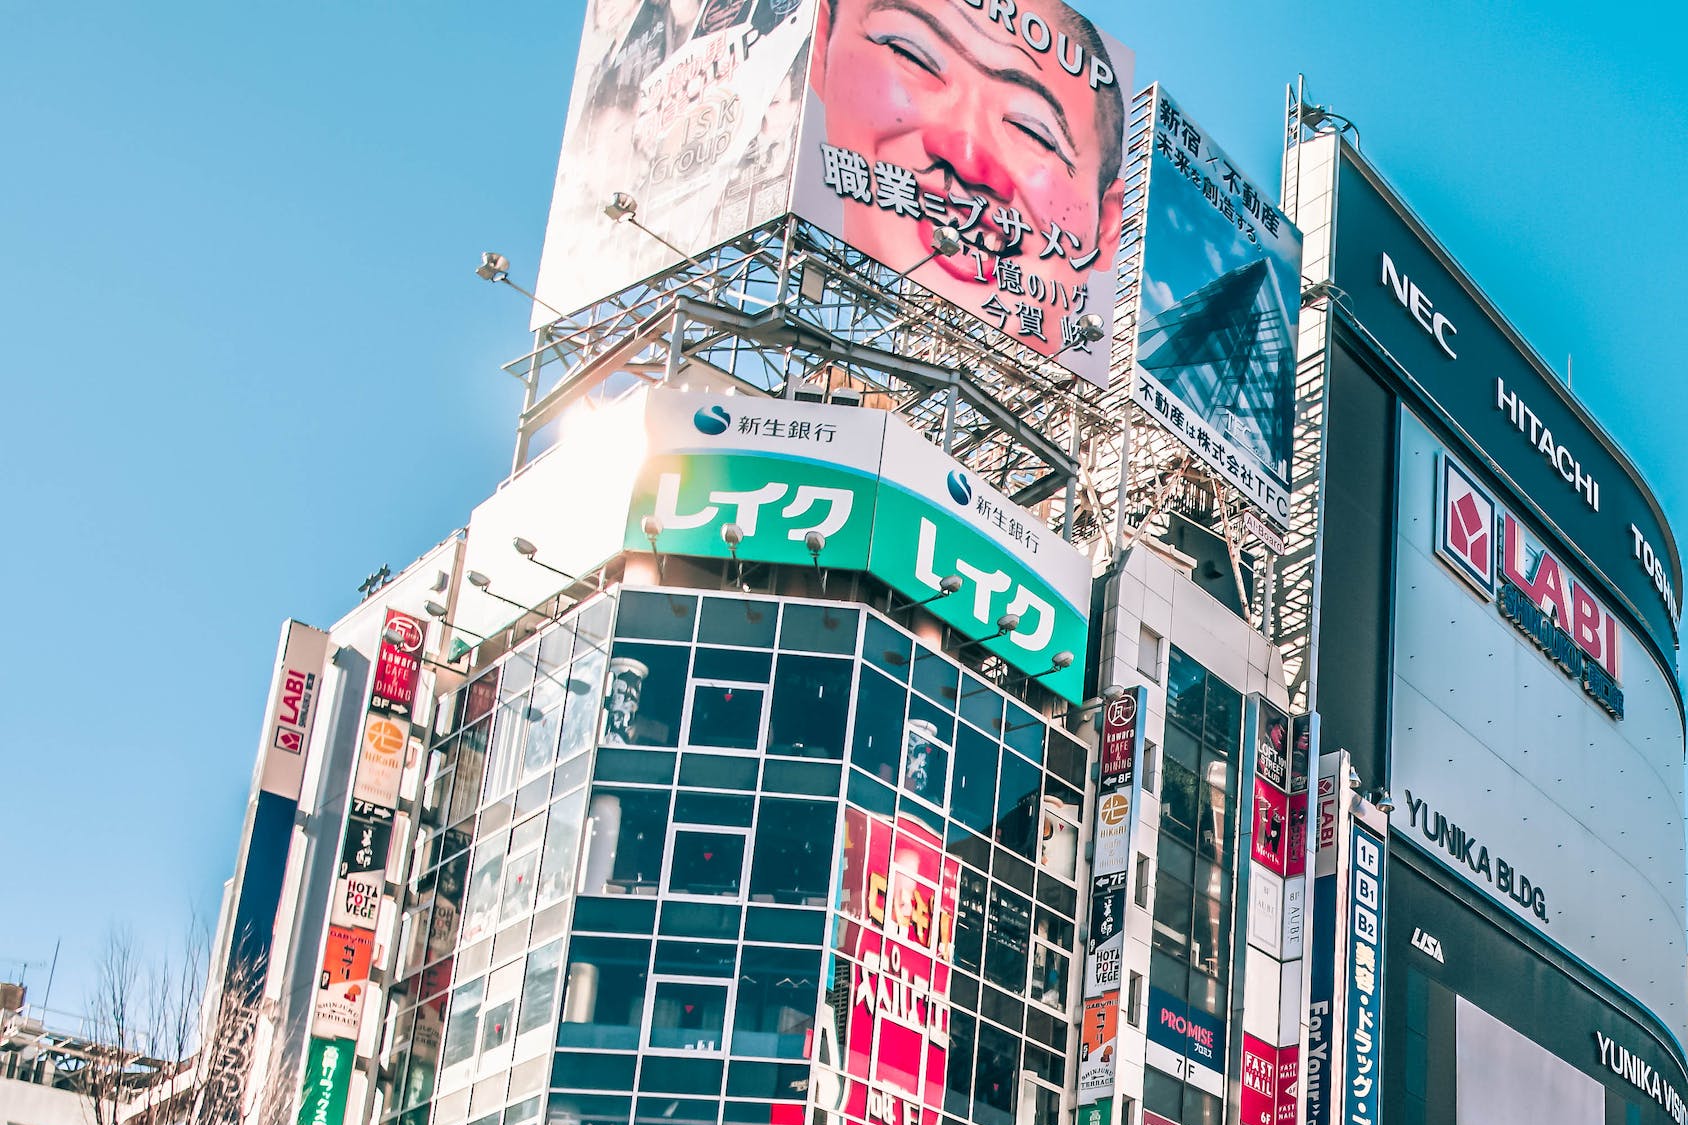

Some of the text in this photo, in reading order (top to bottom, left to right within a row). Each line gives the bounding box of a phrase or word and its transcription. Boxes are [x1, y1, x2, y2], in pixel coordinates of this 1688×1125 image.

[650, 131, 733, 185] Group
[1381, 251, 1458, 360] NEC
[738, 414, 837, 444] 新生銀行
[1138, 375, 1289, 520] 不動産は株式会社TFC
[1497, 376, 1600, 513] HITACHI
[654, 471, 855, 542] レイク
[975, 494, 1040, 556] 新生銀行
[915, 516, 1056, 652] レイク
[1503, 511, 1622, 680] LABI
[279, 669, 306, 726] LABI
[1107, 727, 1135, 744] kawara
[1109, 741, 1129, 756] CAFE
[1258, 738, 1278, 764] LOFT
[1104, 757, 1132, 775] DINING
[1117, 771, 1132, 784] 8F
[1260, 755, 1285, 777] STREET
[1263, 766, 1281, 784] CLUB
[354, 799, 373, 815] 7F
[1320, 799, 1335, 849] LABI
[1359, 845, 1375, 868] 1F
[1404, 788, 1550, 925] YUNIKA BLDG.
[1110, 871, 1126, 887] 7F
[1359, 878, 1375, 903] B1
[345, 902, 374, 920] VEGE
[346, 891, 372, 908] POT
[1359, 914, 1375, 938] B2
[1411, 928, 1445, 965] LISA
[1096, 962, 1116, 974] POT
[1096, 972, 1119, 983] VEGE
[1160, 1006, 1214, 1048] PROMISE
[1194, 1041, 1214, 1059] プロミス
[1307, 1000, 1329, 1104] For Your
[1246, 1052, 1272, 1077] FAST
[1596, 1030, 1662, 1105] YUNIKA
[1244, 1070, 1272, 1097] NAIL
[1260, 1111, 1271, 1125] 6F
